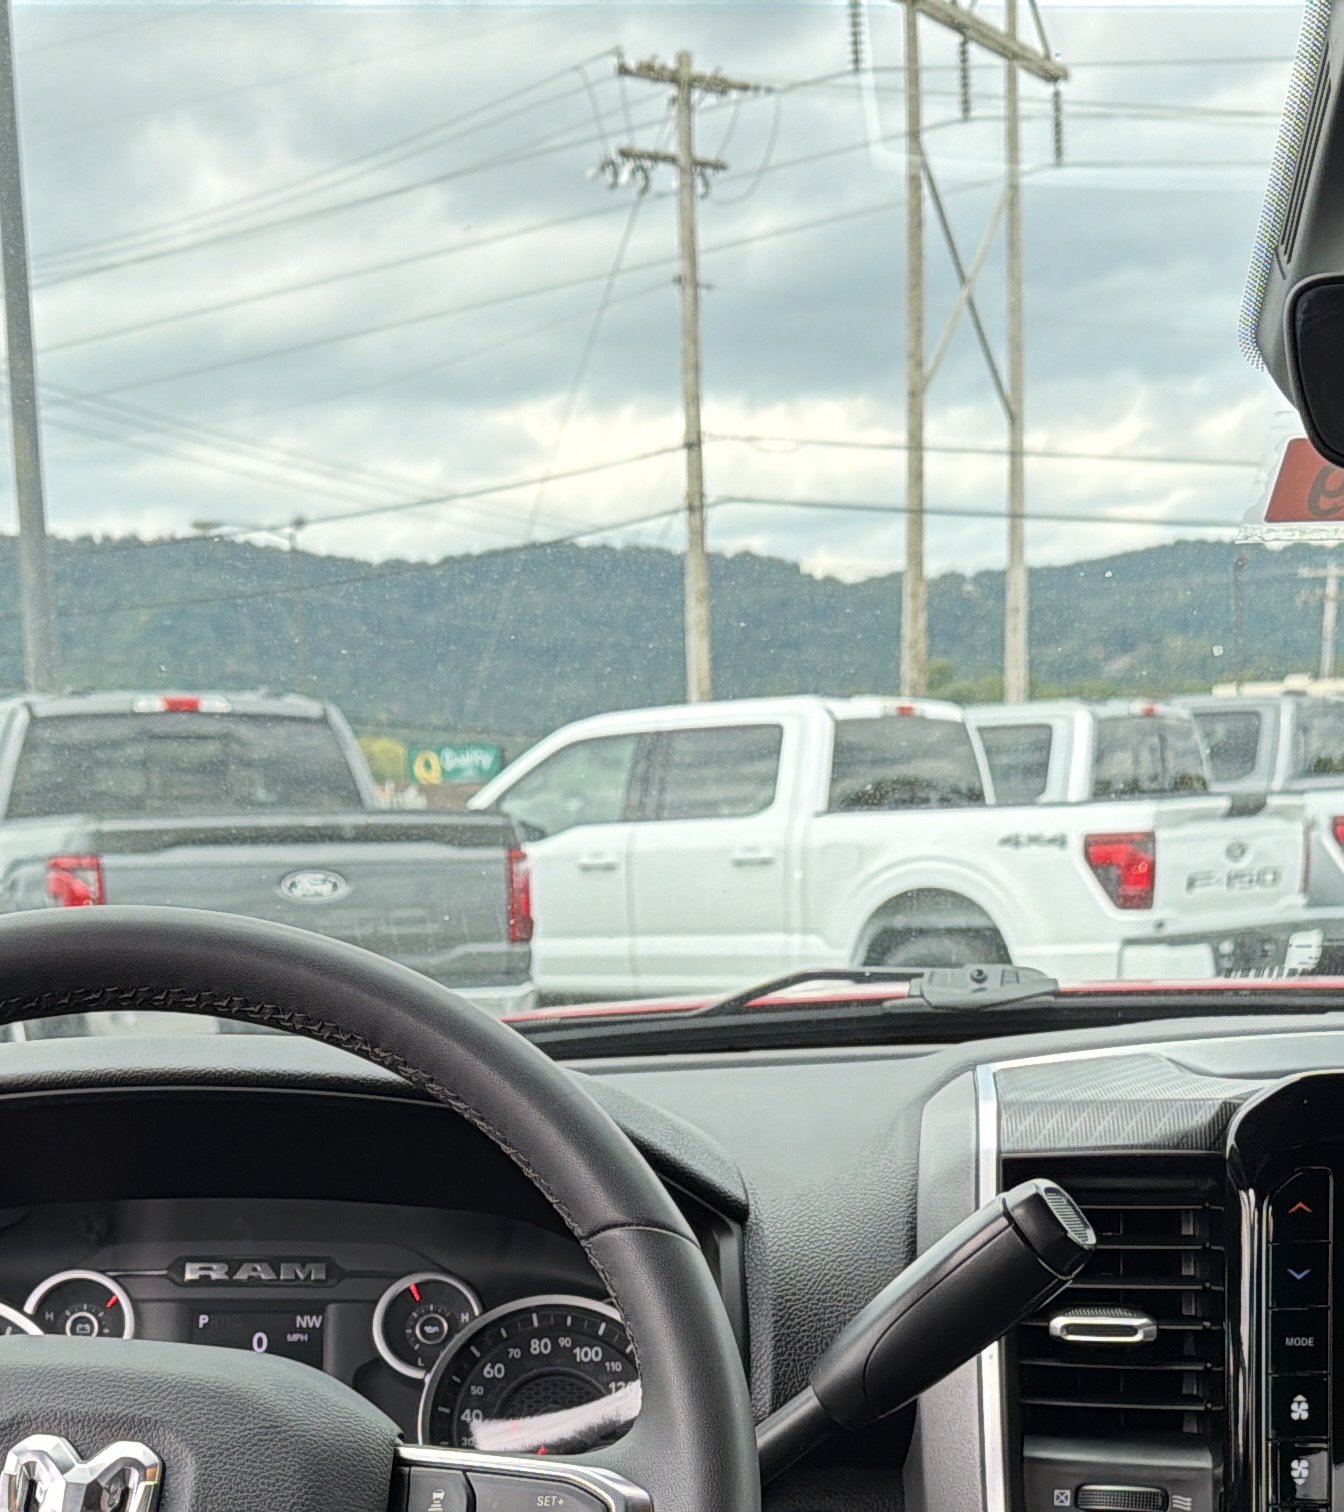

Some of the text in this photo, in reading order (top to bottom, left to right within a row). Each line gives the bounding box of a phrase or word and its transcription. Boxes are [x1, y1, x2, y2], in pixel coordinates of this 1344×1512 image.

[1185, 866, 1283, 894] F-150
[184, 1262, 327, 1281] RAM
[295, 1314, 323, 1330] NW
[252, 1331, 268, 1353] 0
[286, 1333, 309, 1342] MPH
[558, 1336, 572, 1349] 90
[1285, 1336, 1315, 1347] MODE
[507, 1348, 522, 1359] 70
[530, 1338, 552, 1355] 80
[573, 1346, 603, 1363] 100
[483, 1362, 505, 1379] 60
[606, 1361, 622, 1372] 110
[470, 1385, 485, 1396] 50
[460, 1408, 484, 1424] 40
